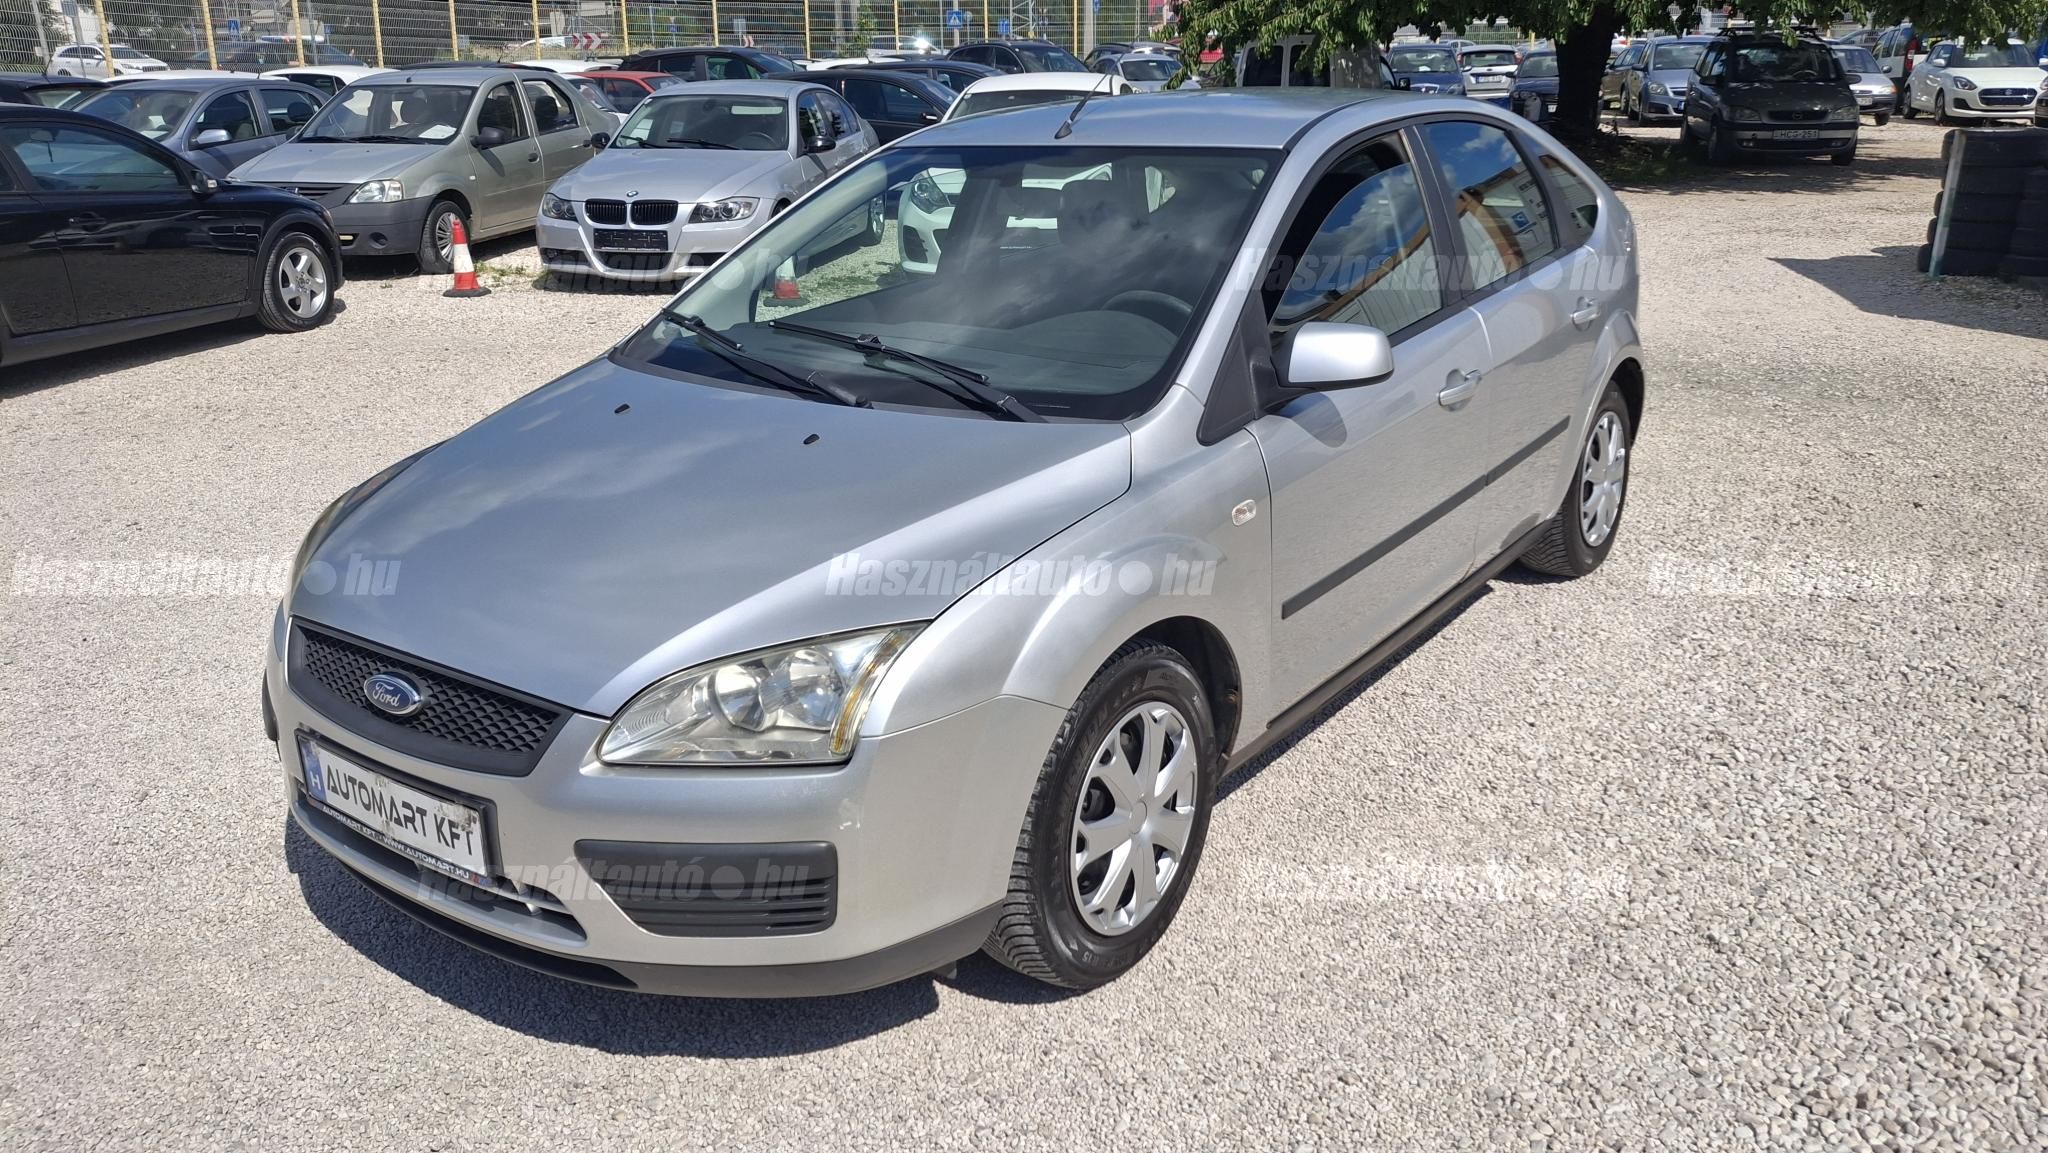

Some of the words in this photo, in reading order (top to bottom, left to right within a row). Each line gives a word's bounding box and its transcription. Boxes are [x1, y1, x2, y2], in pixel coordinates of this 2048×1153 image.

[372, 681, 401, 708] Ford
[310, 772, 322, 789] H
[326, 764, 427, 838] AUTOMART
[433, 811, 478, 856] KFT
